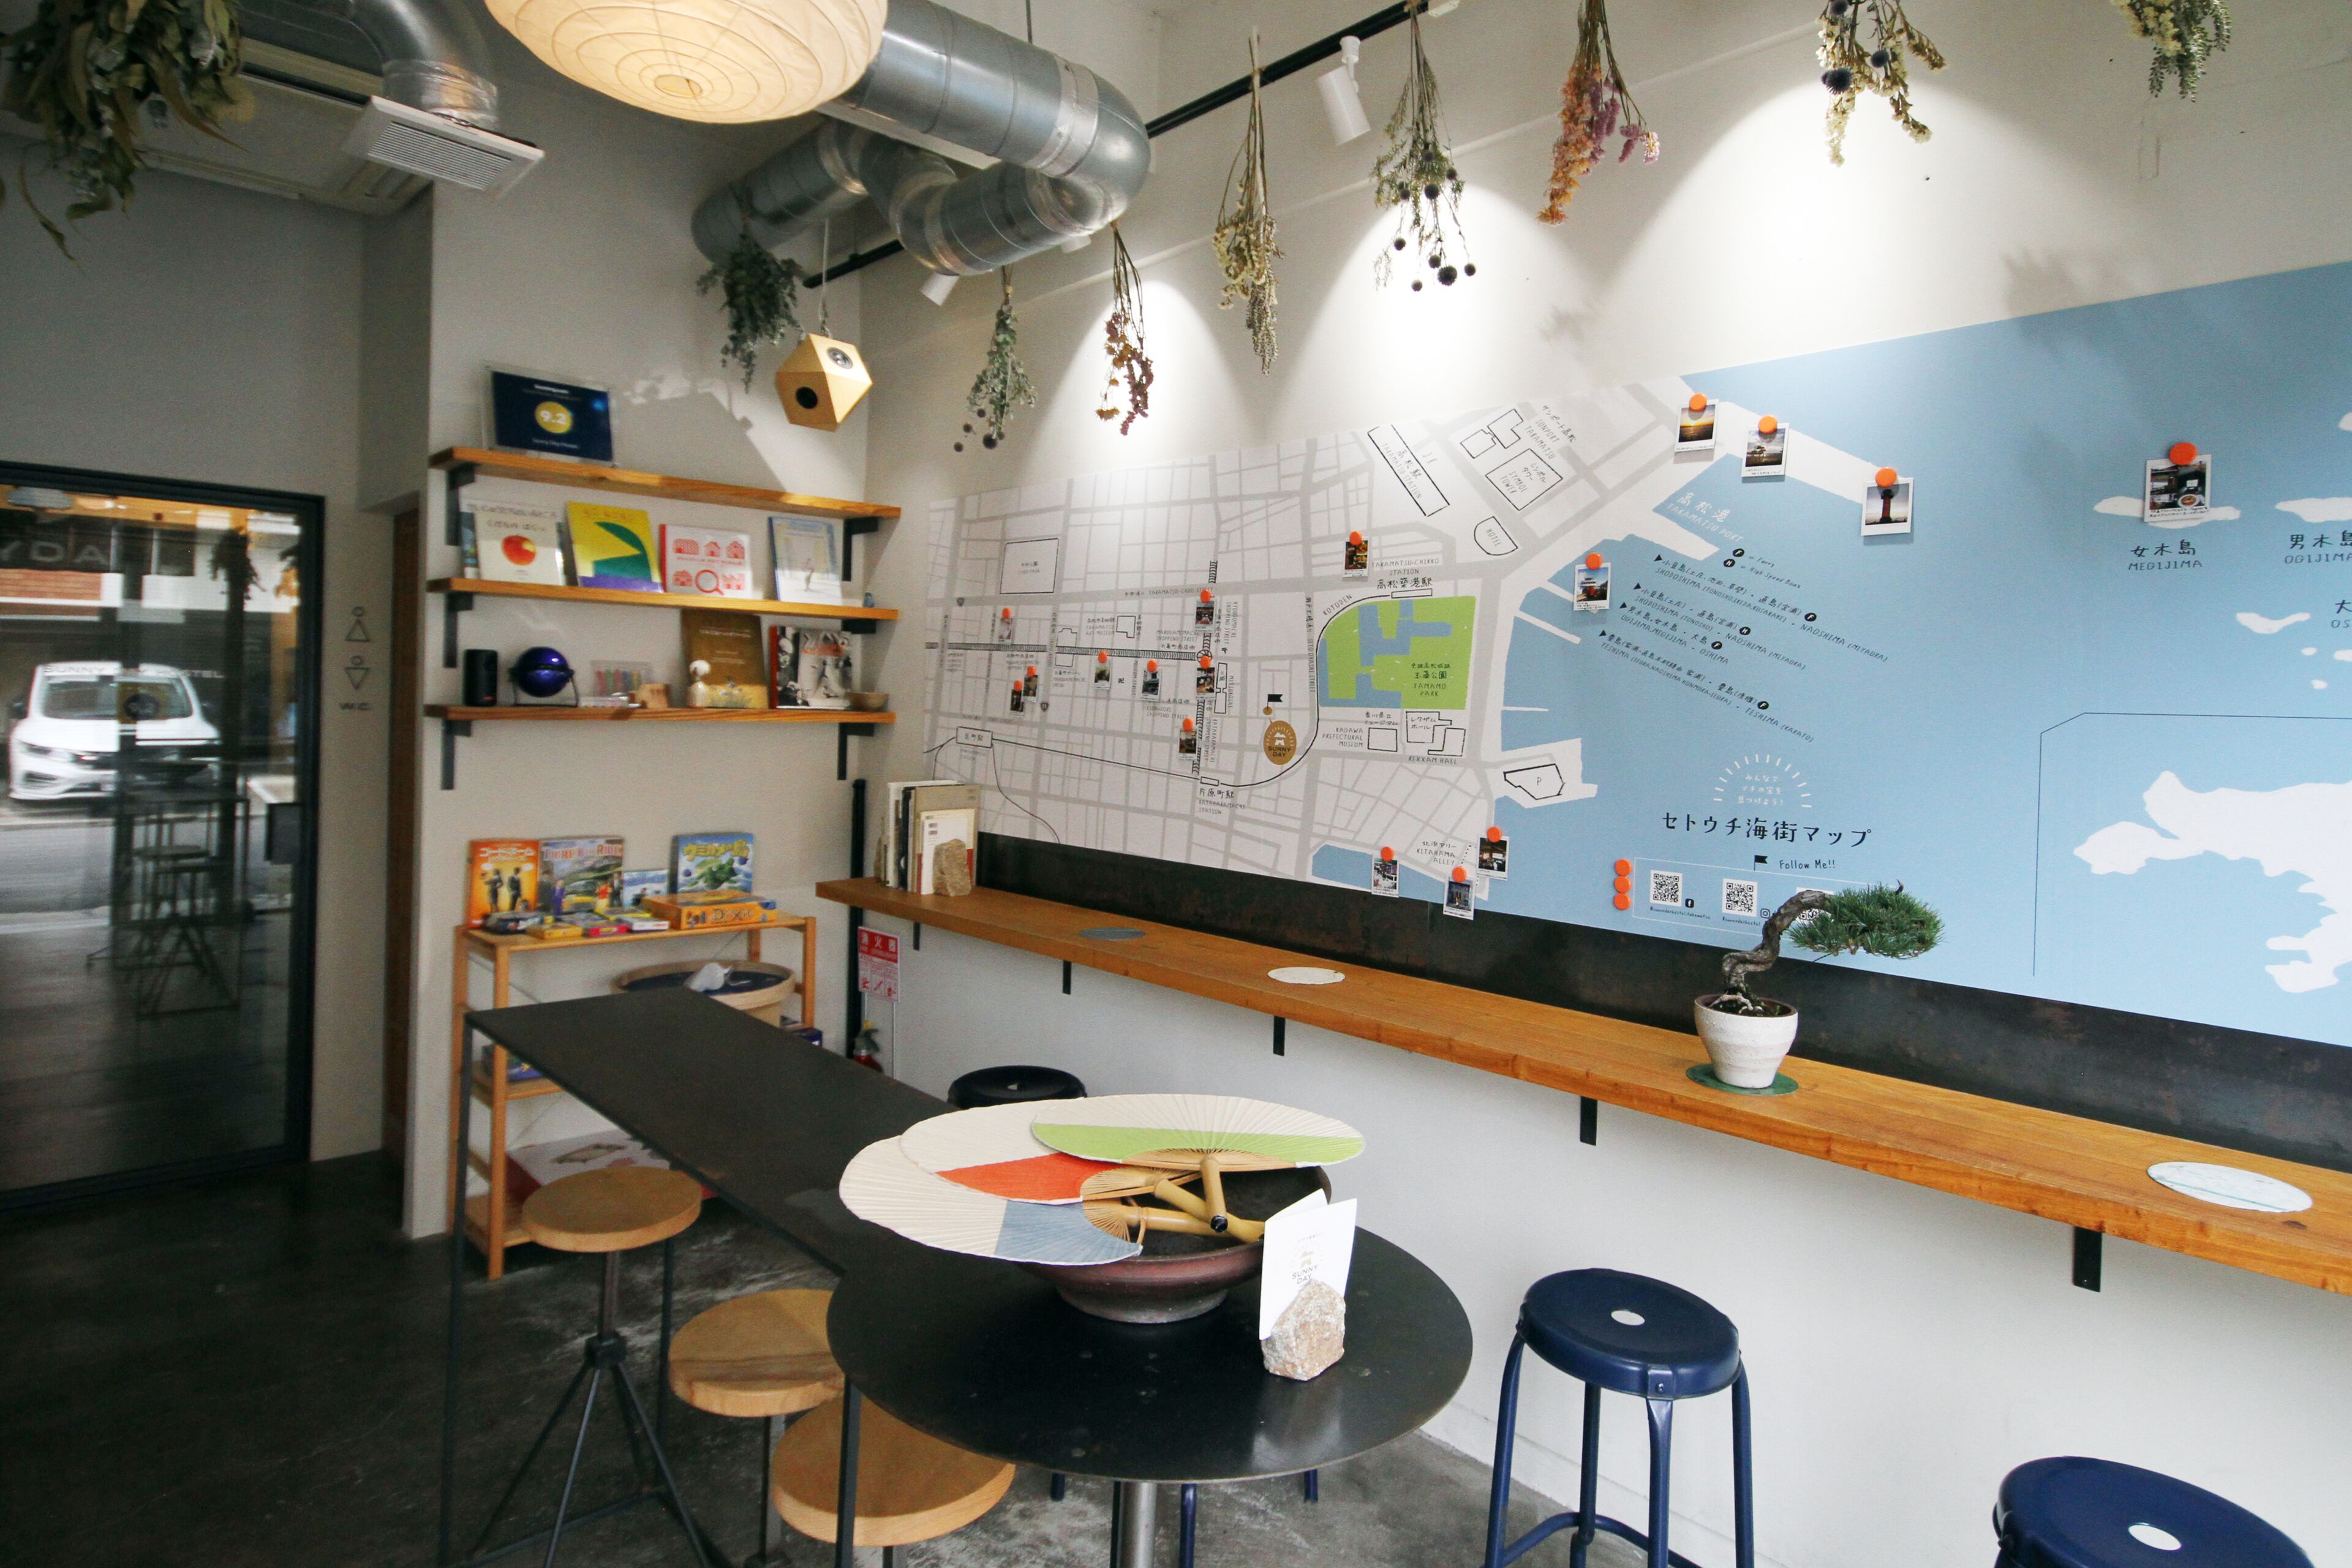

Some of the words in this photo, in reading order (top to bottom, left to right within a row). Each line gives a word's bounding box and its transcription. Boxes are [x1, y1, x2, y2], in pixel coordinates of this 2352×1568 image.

[540, 410, 567, 426] 9.2
[1535, 419, 1560, 443] SUNPORT
[1524, 425, 1557, 460] TAKAMATSU
[1381, 443, 1406, 476] TAKAMATSU
[1403, 473, 1423, 500] STATION
[1396, 449, 1422, 479] 高松駅
[1500, 475, 1517, 494] TOWER
[1509, 470, 1528, 493] SYMBOL
[1677, 492, 1732, 522] 高松港
[1666, 503, 1717, 532] TAKAMATSU
[1719, 526, 1744, 543] PORT
[1485, 528, 1502, 547] HOTEL
[2290, 530, 2352, 550] 男木島
[2131, 539, 2196, 557] 女木島
[1371, 558, 1439, 568] TAKAMATSU-CHIKKO
[2128, 560, 2203, 571] MEGIJIMA
[1377, 578, 1433, 590] 高松築港駅
[1322, 594, 1352, 616] KOTODEN
[1656, 567, 1700, 589] SHODOSHIMA
[1800, 623, 1846, 645] NAOSHIMA
[1634, 596, 1679, 617] SHODOSHIMA
[1725, 633, 1766, 655] NAOSHIMA
[1691, 633, 1708, 645] 大島
[1700, 648, 1728, 665] OSHIMA
[1600, 642, 1629, 659] TESHIMA
[1745, 707, 1779, 726] TESHIMA
[1781, 723, 1814, 743] (KARATO)
[1537, 775, 1542, 786] P
[1199, 788, 1234, 799] 片原町駅
[1662, 812, 1872, 848] セトウチ海街マップ
[682, 839, 750, 862] ウミガメの島
[1417, 848, 1455, 858] KITAHAMA
[1433, 857, 1455, 866] ALLEY
[1779, 859, 1810, 870] Follow
[1815, 859, 1836, 870] Me!!
[1292, 1264, 1319, 1280] SUNNY
[1297, 1274, 1312, 1284] DAY
